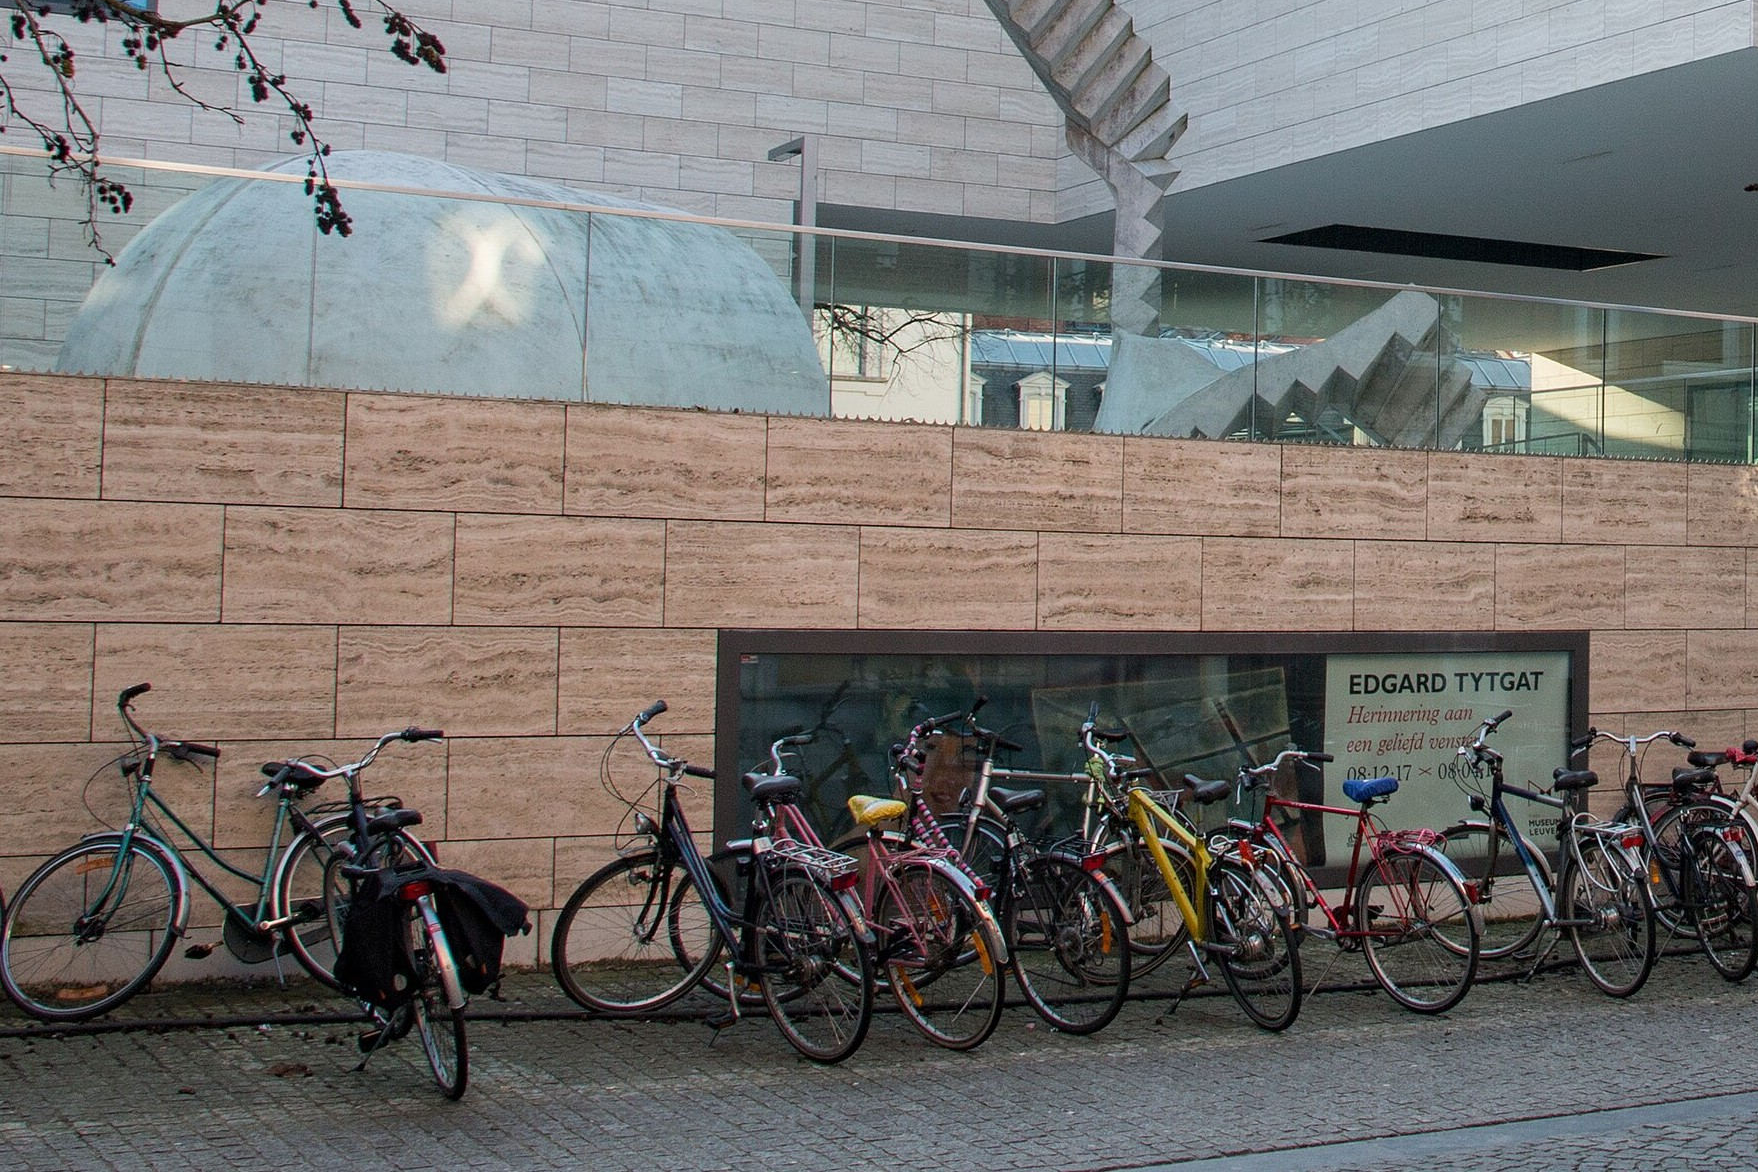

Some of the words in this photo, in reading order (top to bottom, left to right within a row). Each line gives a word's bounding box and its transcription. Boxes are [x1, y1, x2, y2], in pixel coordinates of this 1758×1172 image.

[1349, 673, 1447, 695] EDGARD
[1454, 671, 1544, 692] TYTGAT
[1347, 704, 1441, 725] Herinnering
[1444, 707, 1473, 722] aan
[1346, 739, 1372, 753] een
[1376, 732, 1425, 756] geliefd
[1529, 827, 1561, 837] LEUVE
